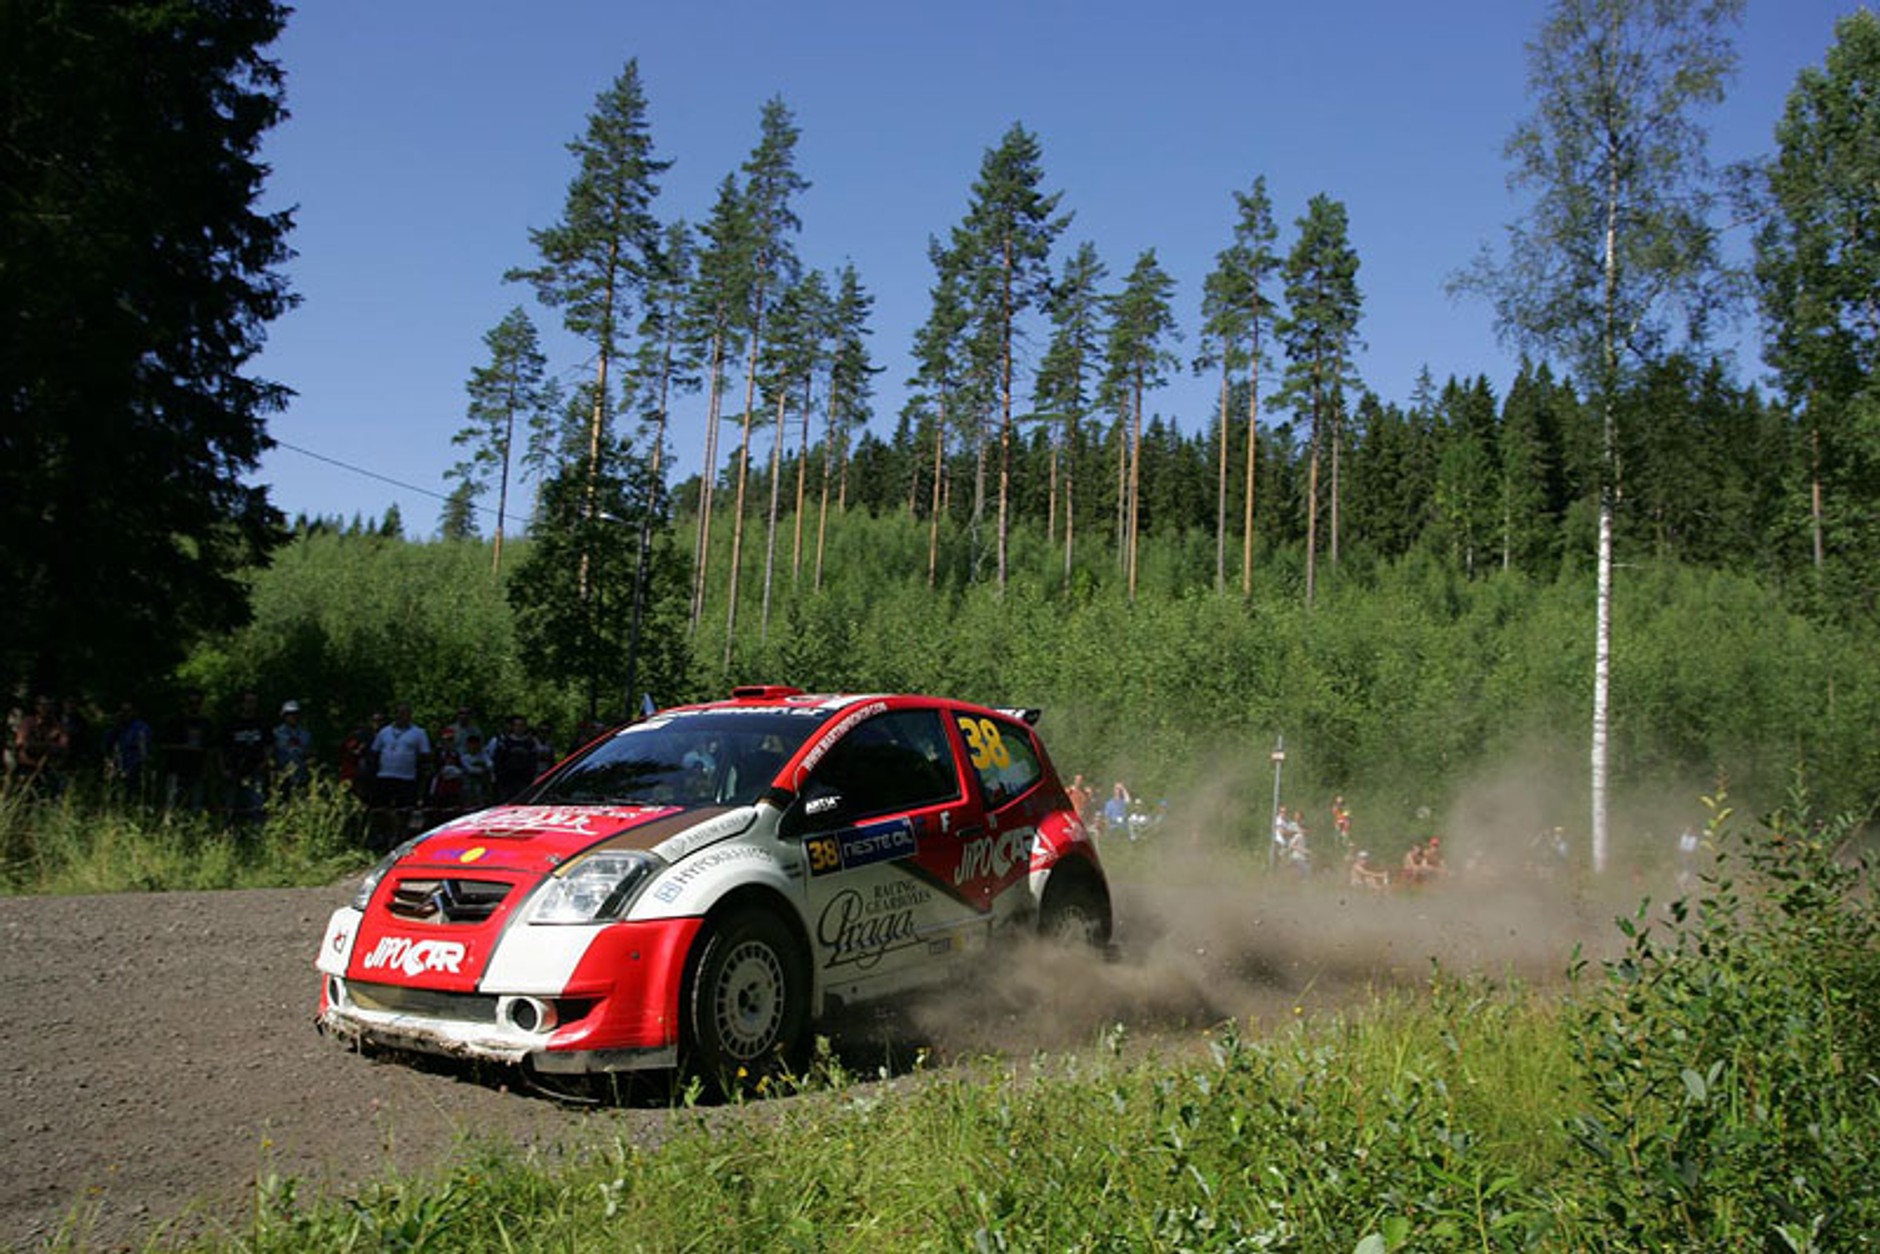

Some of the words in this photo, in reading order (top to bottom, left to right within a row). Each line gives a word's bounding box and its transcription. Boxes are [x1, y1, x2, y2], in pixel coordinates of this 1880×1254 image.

[957, 716, 1009, 770] 38
[809, 839, 838, 870] 38
[818, 888, 930, 970] Praga
[364, 936, 465, 977] JIPOCAR
